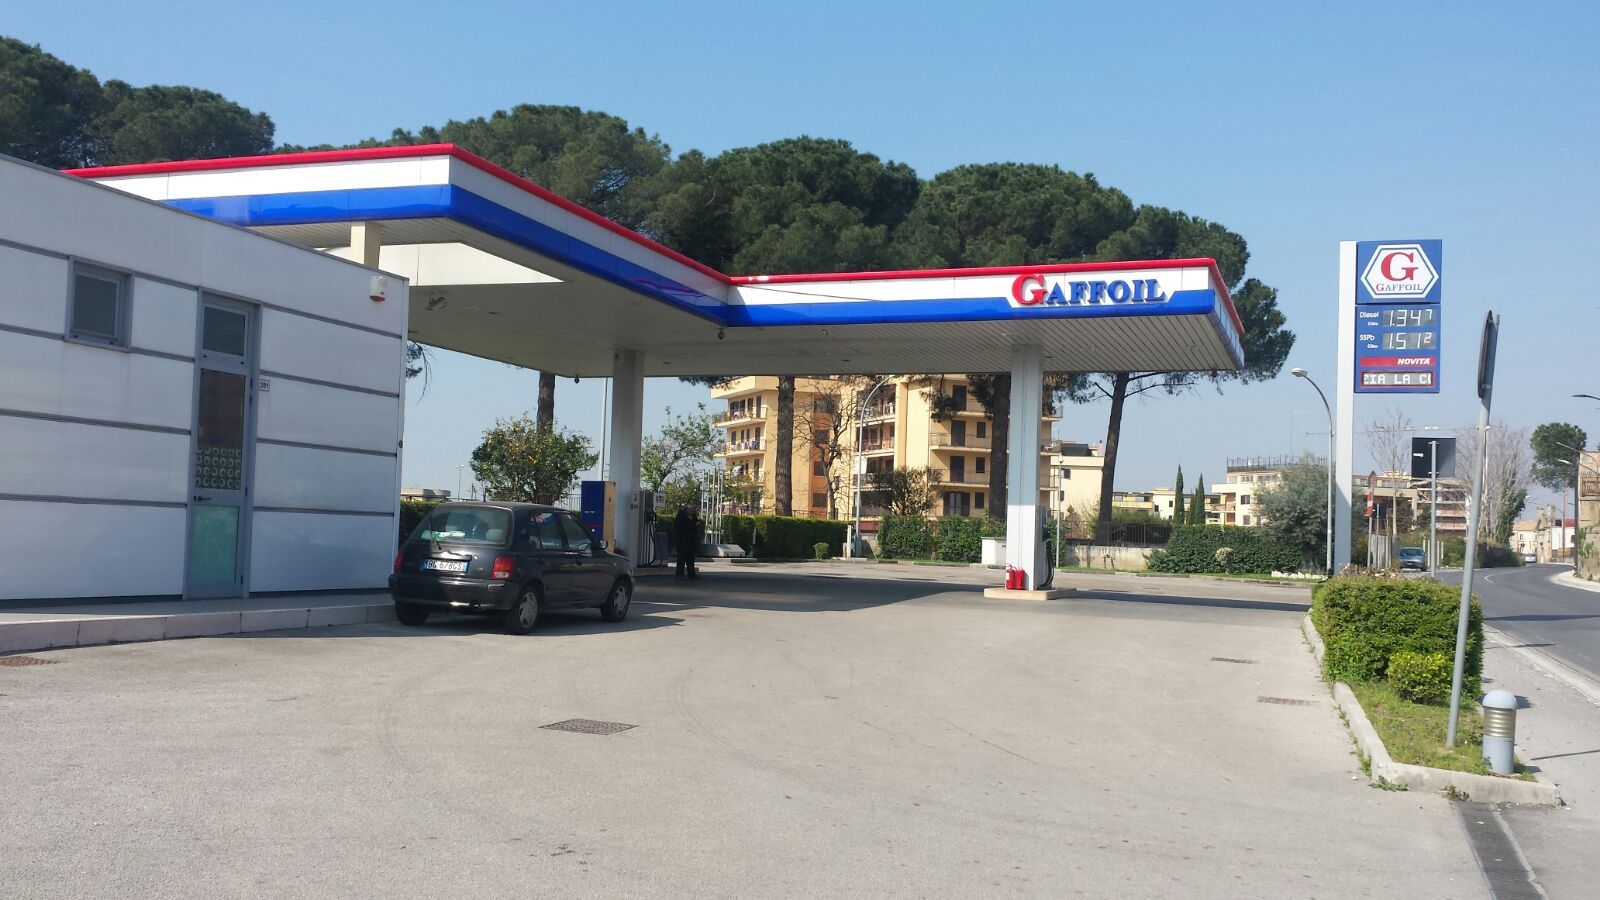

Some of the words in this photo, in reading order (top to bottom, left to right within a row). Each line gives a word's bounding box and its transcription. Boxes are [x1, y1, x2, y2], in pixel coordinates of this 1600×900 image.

[1381, 252, 1418, 281] G
[1011, 273, 1166, 305] GAFFOIL
[1375, 283, 1423, 291] GAFFOIL
[1389, 309, 1433, 326] 1.347
[1389, 332, 1433, 349] 1.512
[1394, 374, 1411, 385] LA
